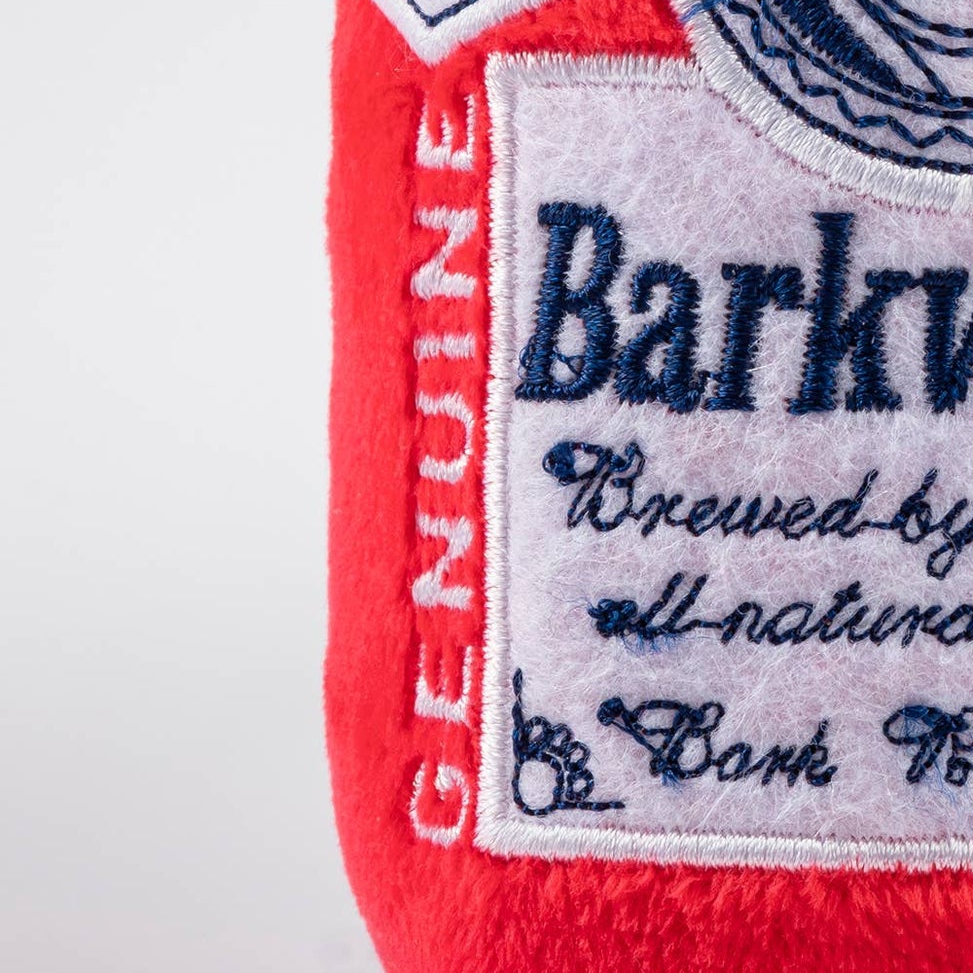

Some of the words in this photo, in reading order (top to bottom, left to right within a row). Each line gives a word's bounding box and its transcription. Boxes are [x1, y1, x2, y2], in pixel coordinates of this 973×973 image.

[406, 93, 480, 847] GENUINE
[542, 440, 877, 539] Brewed
[592, 572, 691, 640] all
[600, 697, 838, 787] Bark
